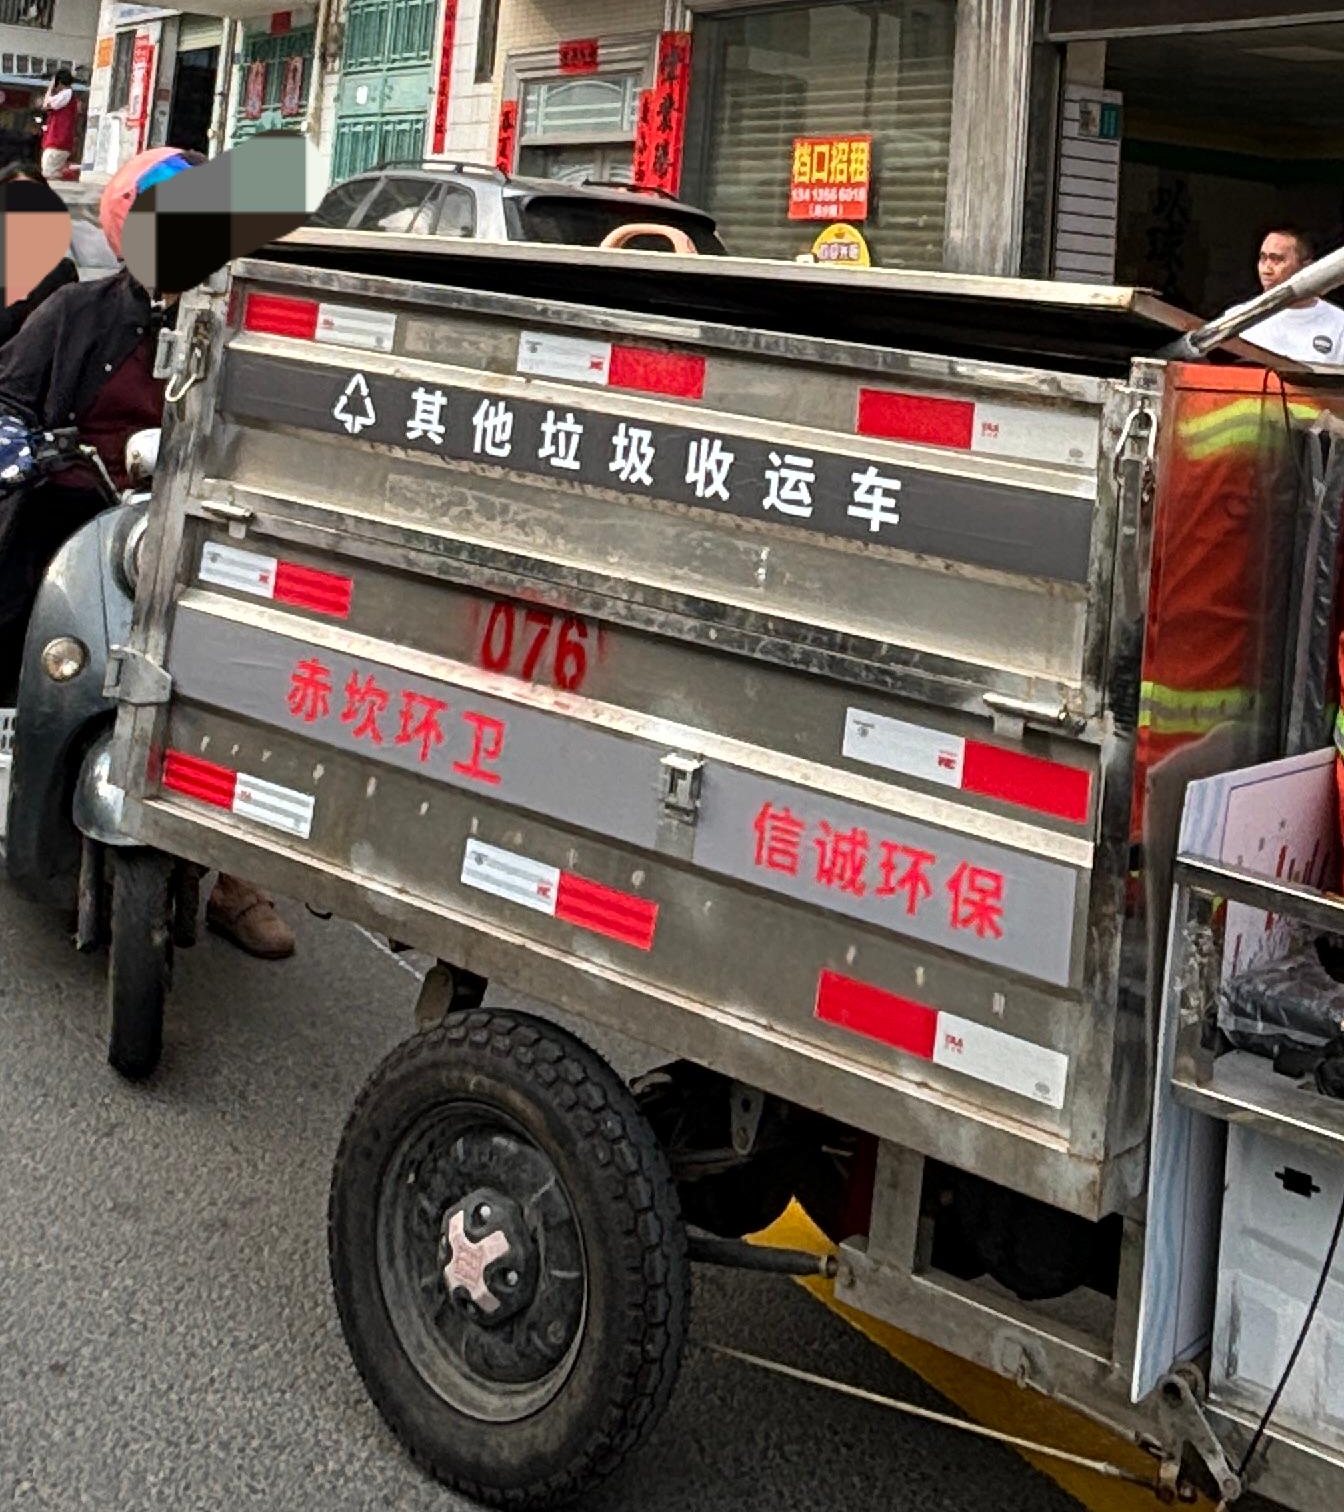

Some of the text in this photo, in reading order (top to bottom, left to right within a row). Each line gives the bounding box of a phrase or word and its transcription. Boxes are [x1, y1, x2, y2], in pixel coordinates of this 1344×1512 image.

[793, 141, 871, 184] 档口招租
[406, 386, 902, 533] 其他垃圾收运车
[480, 599, 589, 693] 076
[287, 657, 506, 785] 赤坎环卫
[753, 800, 1006, 939] 信诚环保
